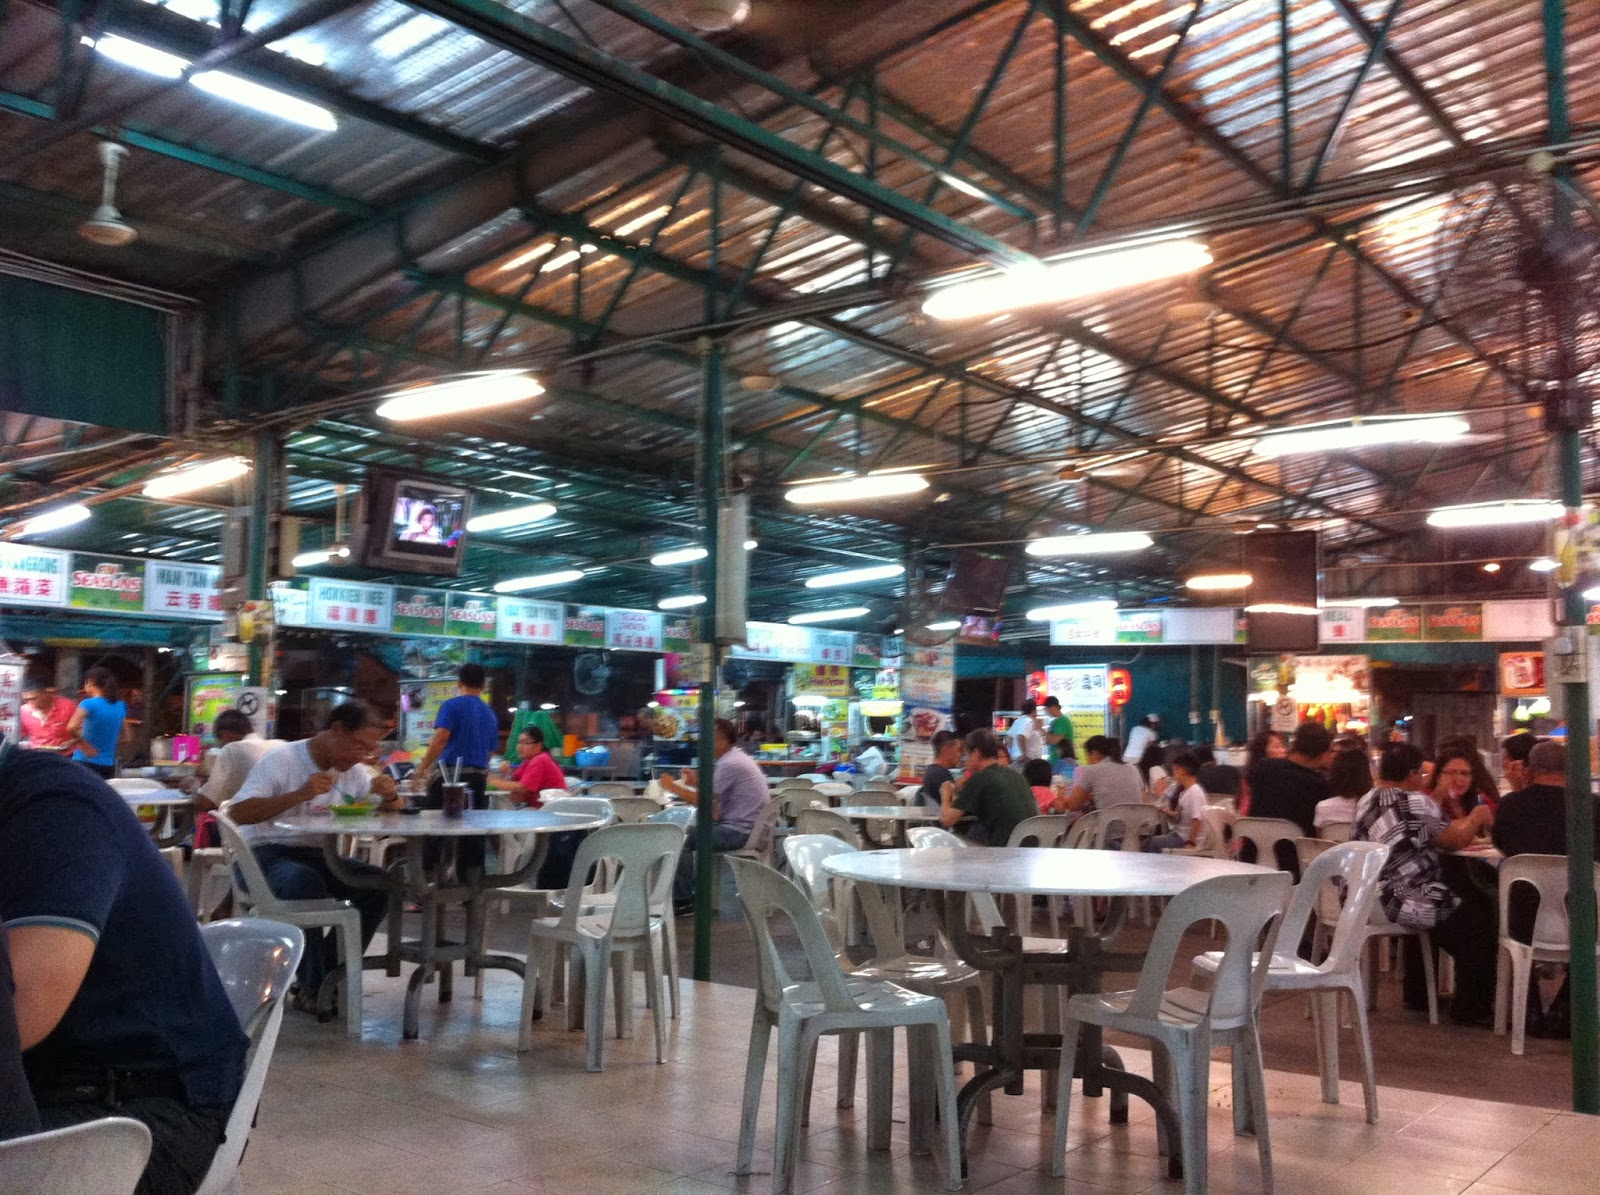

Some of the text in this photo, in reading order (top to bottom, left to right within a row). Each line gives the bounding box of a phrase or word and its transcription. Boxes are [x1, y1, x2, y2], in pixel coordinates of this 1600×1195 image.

[71, 571, 142, 591] SEASONS
[395, 602, 443, 619] SEASONS
[449, 607, 496, 624] SEASONS
